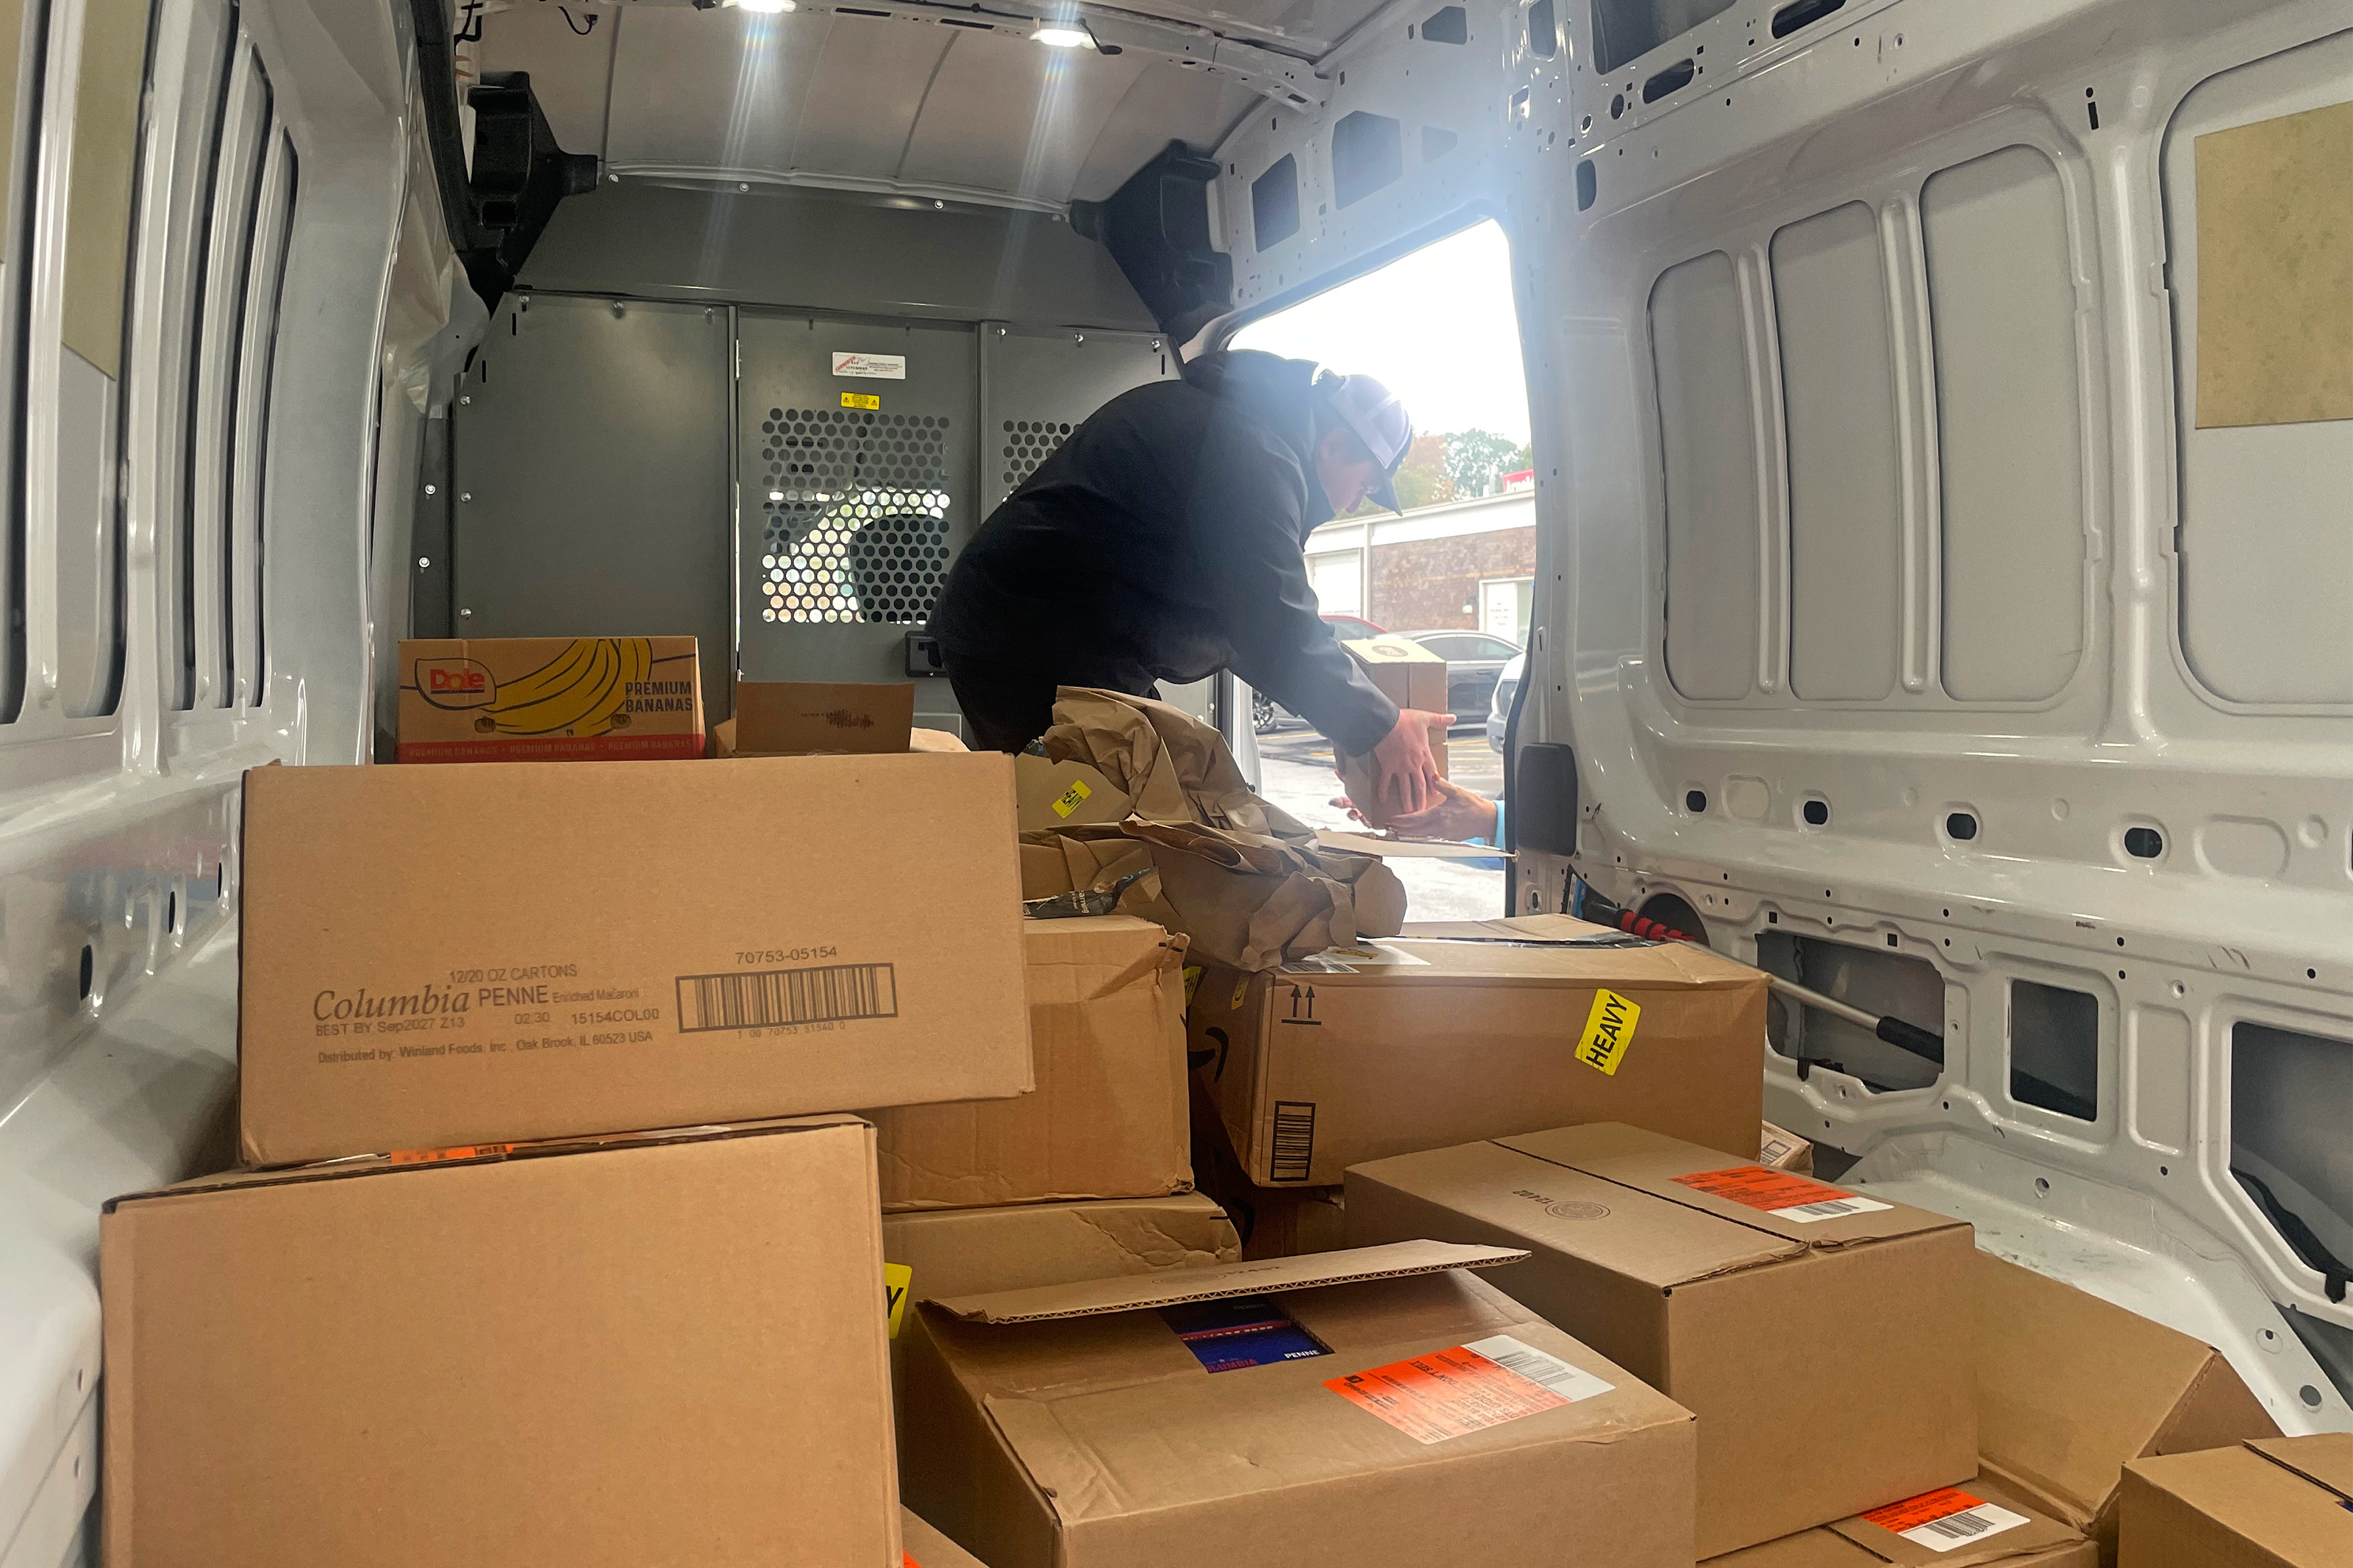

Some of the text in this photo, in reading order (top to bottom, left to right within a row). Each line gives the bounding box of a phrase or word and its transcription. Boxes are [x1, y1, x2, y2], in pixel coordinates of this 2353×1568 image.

[430, 669, 485, 690] Dole
[625, 681, 692, 696] PREMIUM
[625, 698, 693, 713] BANANAS
[1060, 787, 1085, 811] HEAVY
[735, 946, 838, 964] 70753-05154
[449, 964, 578, 984] 12/20 OZ CARTONS
[313, 984, 470, 1022] Columbia
[479, 985, 549, 1007] PENNE
[316, 1023, 349, 1037] BEST
[354, 1022, 373, 1034] BY
[440, 1016, 465, 1029] Z13
[1585, 993, 1627, 1068] HEAVY
[318, 1048, 375, 1064] Distributed
[399, 1043, 446, 1058] Winland
[516, 1038, 538, 1051] Oak
[579, 1034, 590, 1046] IL
[593, 1032, 626, 1045] 60523
[628, 1031, 654, 1043] USA
[1284, 1350, 1321, 1359] PENNE
